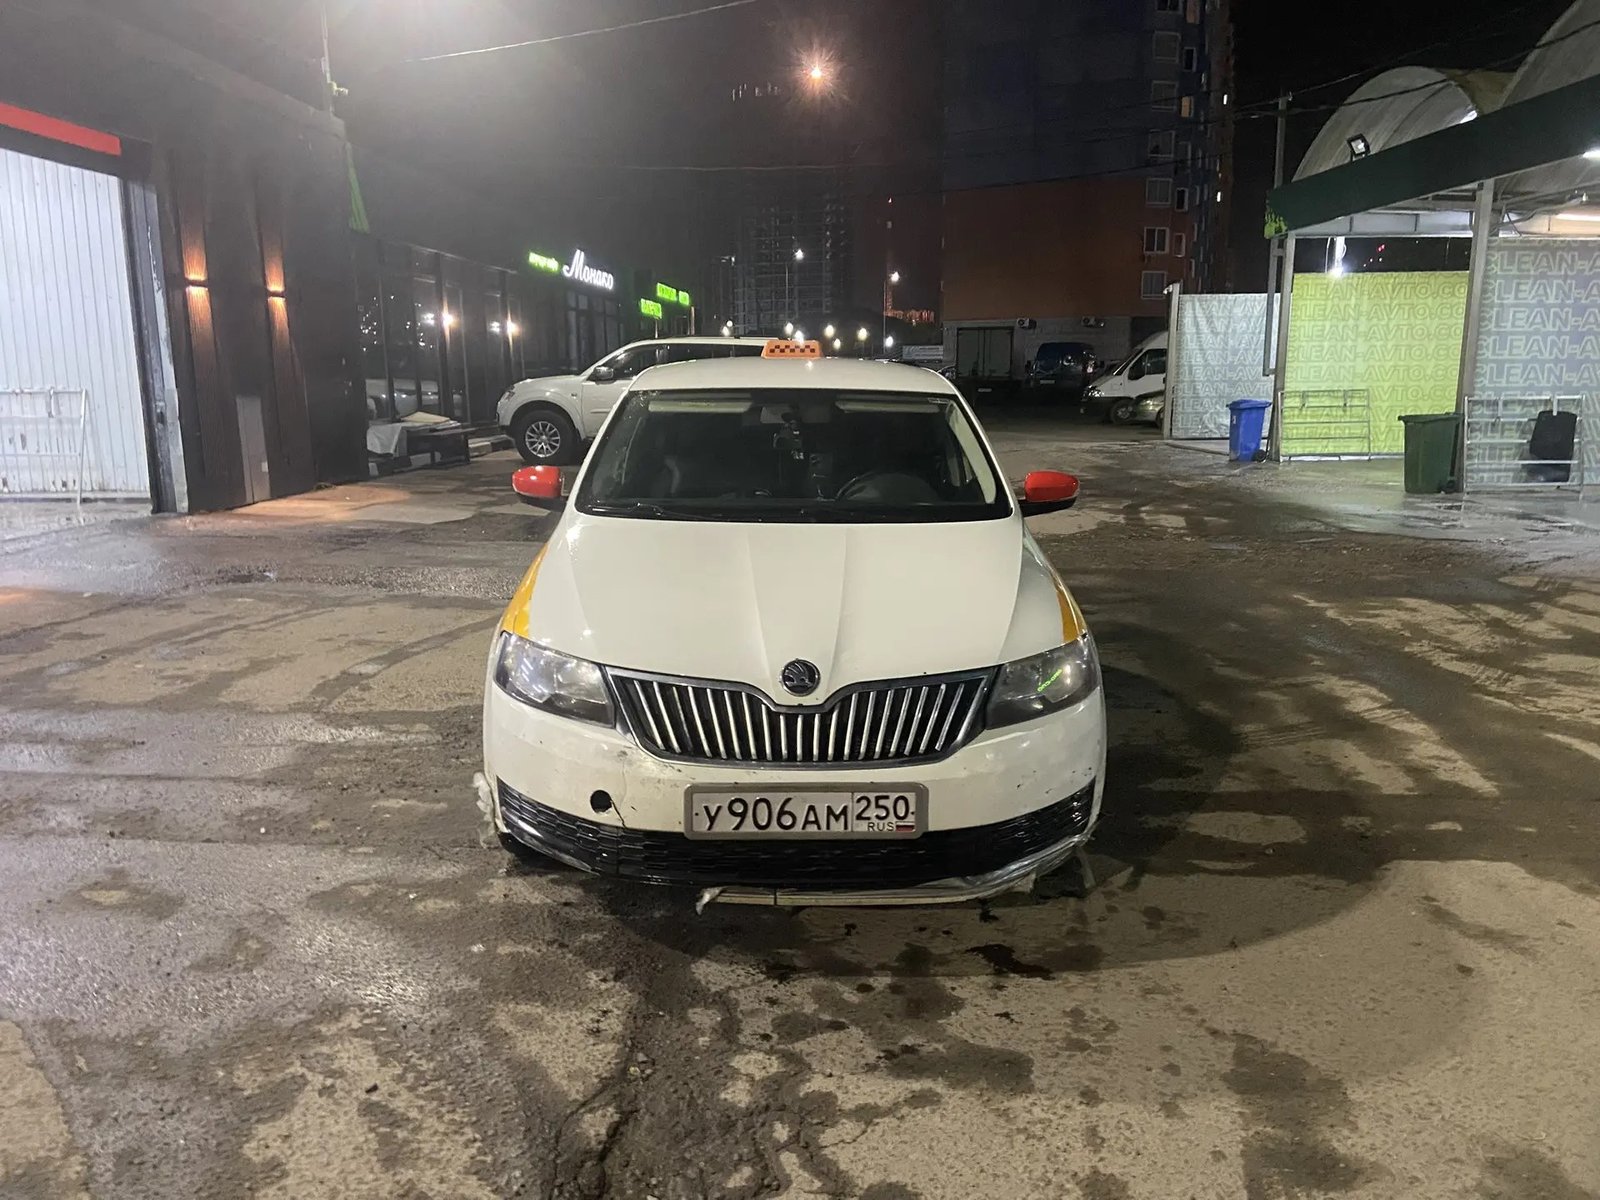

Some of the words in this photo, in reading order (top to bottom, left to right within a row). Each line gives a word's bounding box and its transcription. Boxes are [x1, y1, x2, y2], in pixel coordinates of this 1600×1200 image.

[562, 249, 614, 290] Монако
[703, 797, 849, 831] У906АМ
[855, 795, 910, 821] 250
[867, 821, 895, 832] RUS
